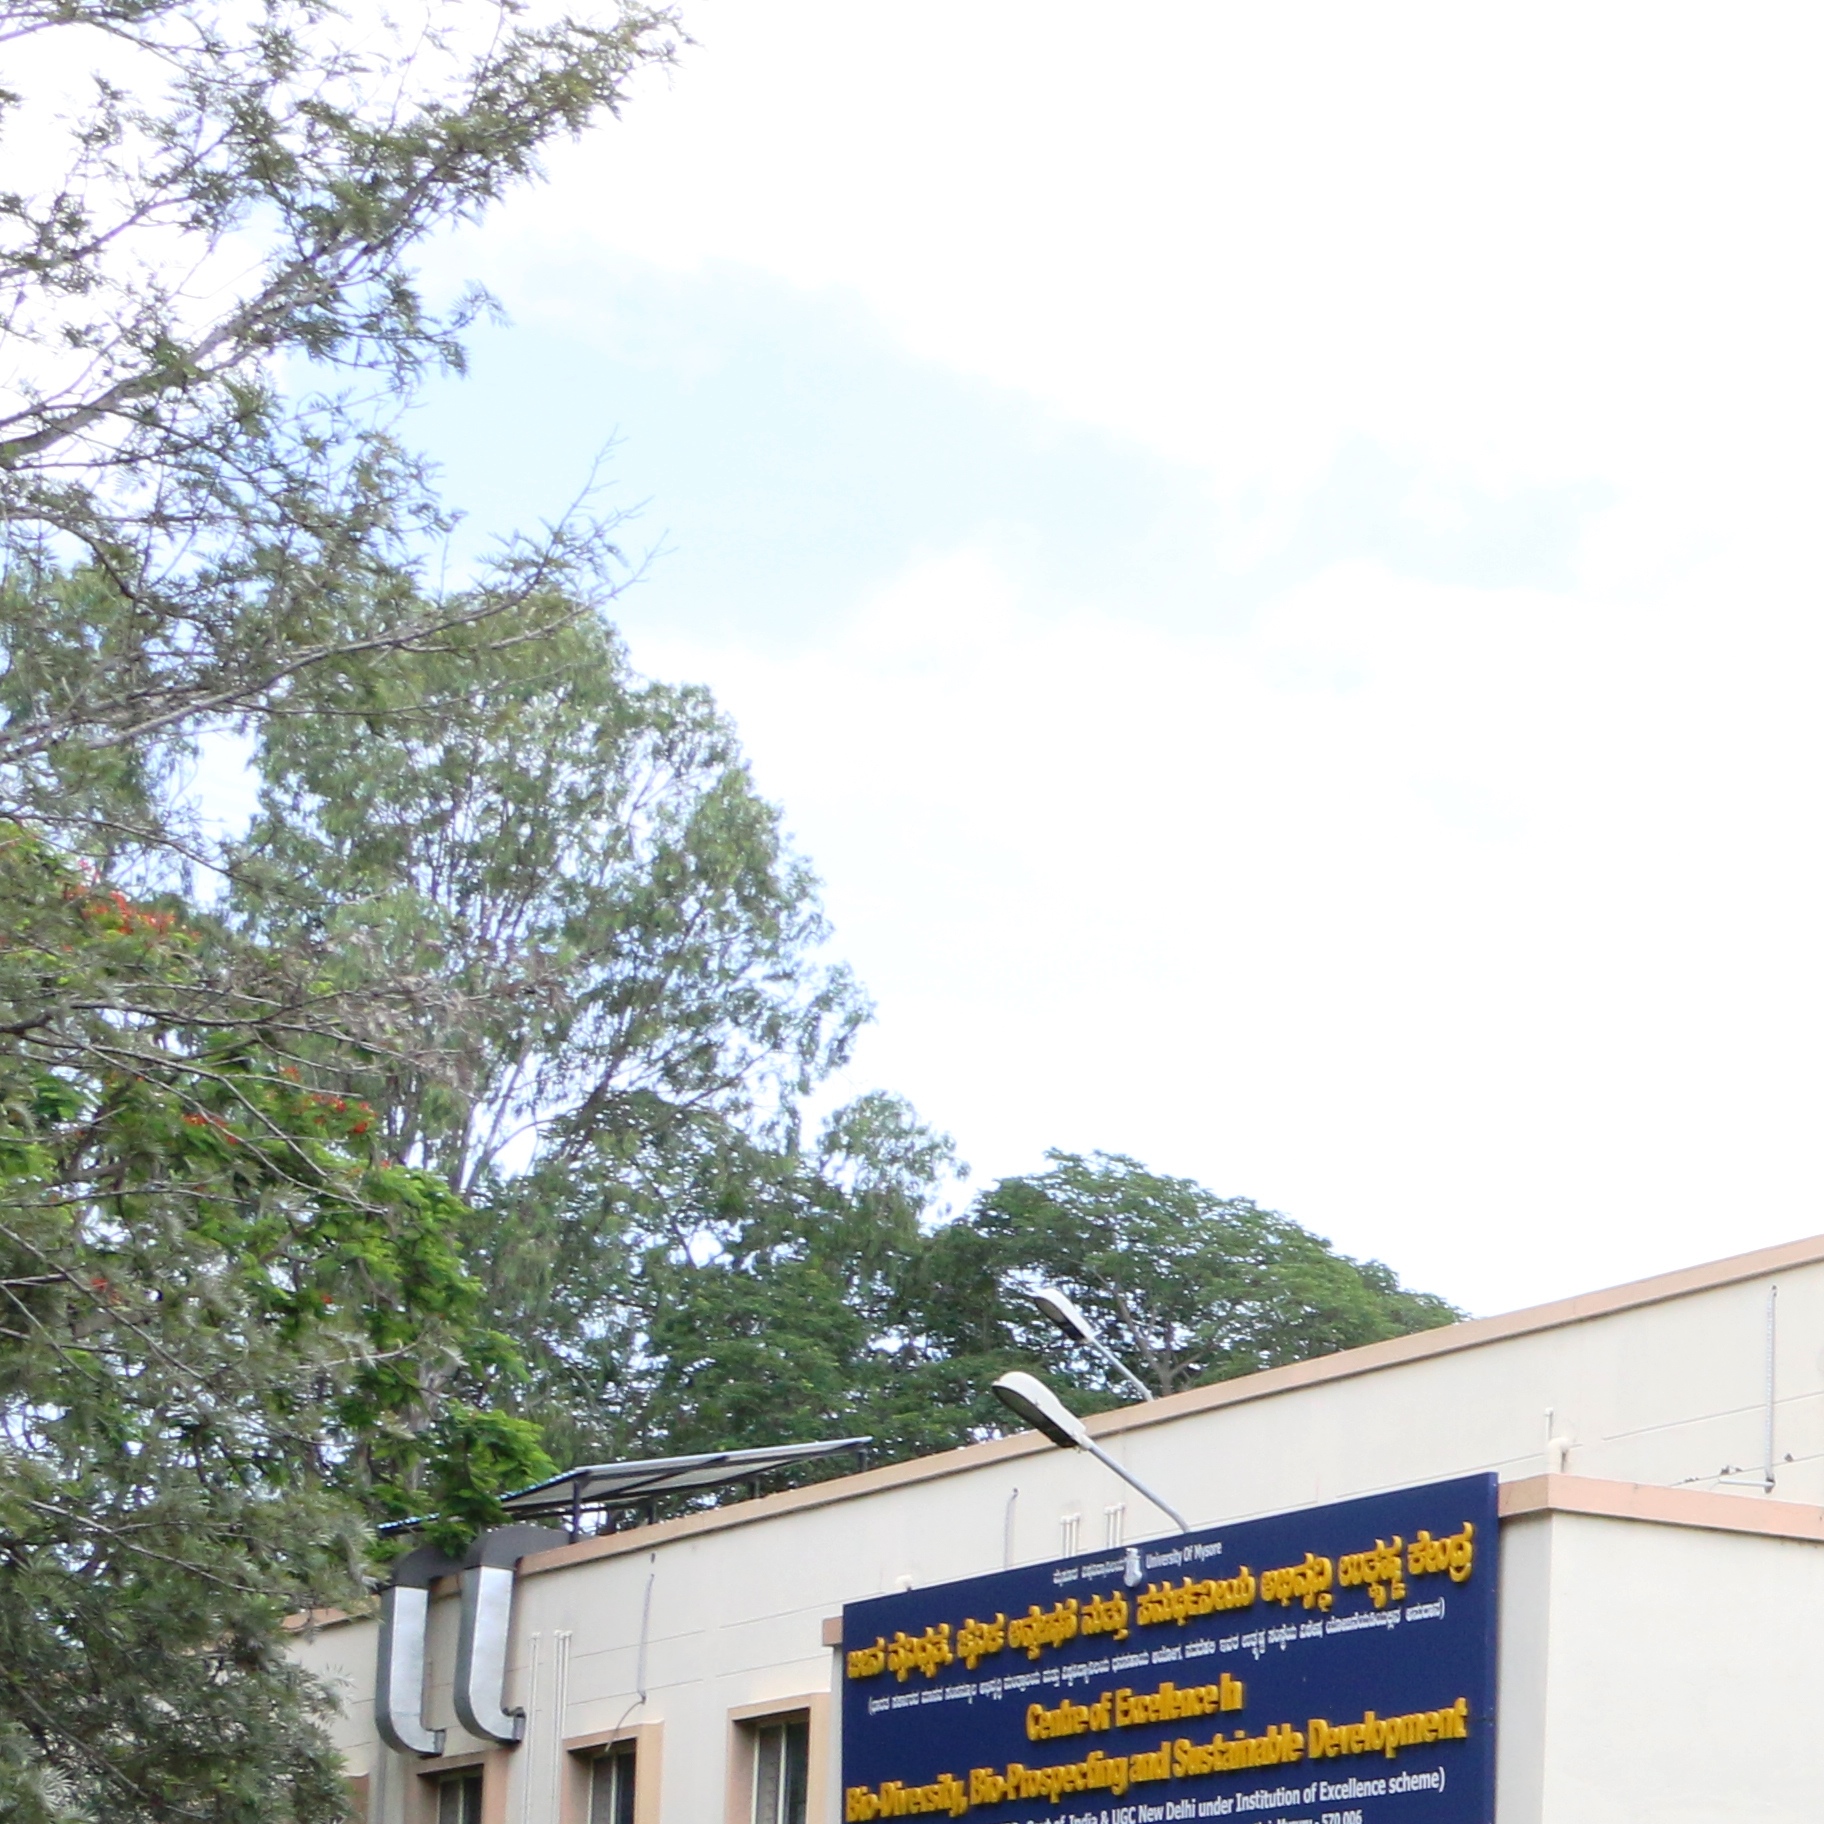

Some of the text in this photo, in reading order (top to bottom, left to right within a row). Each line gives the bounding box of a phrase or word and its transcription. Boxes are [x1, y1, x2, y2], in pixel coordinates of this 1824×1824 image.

[1026, 1699, 1088, 1740] Centre
[1089, 1692, 1112, 1731] of
[1115, 1682, 1219, 1727] Excellence
[1129, 1741, 1171, 1782] and
[1173, 1723, 1304, 1777] Sustainable
[1307, 1697, 1467, 1758] Development
[1138, 1805, 1164, 1824] New
[1167, 1799, 1196, 1819] Delhi
[1199, 1797, 1232, 1817] under
[1235, 1787, 1300, 1812] Institution
[1303, 1785, 1316, 1803] of
[1320, 1775, 1386, 1801] Excellence
[1388, 1767, 1445, 1794] scheme)
